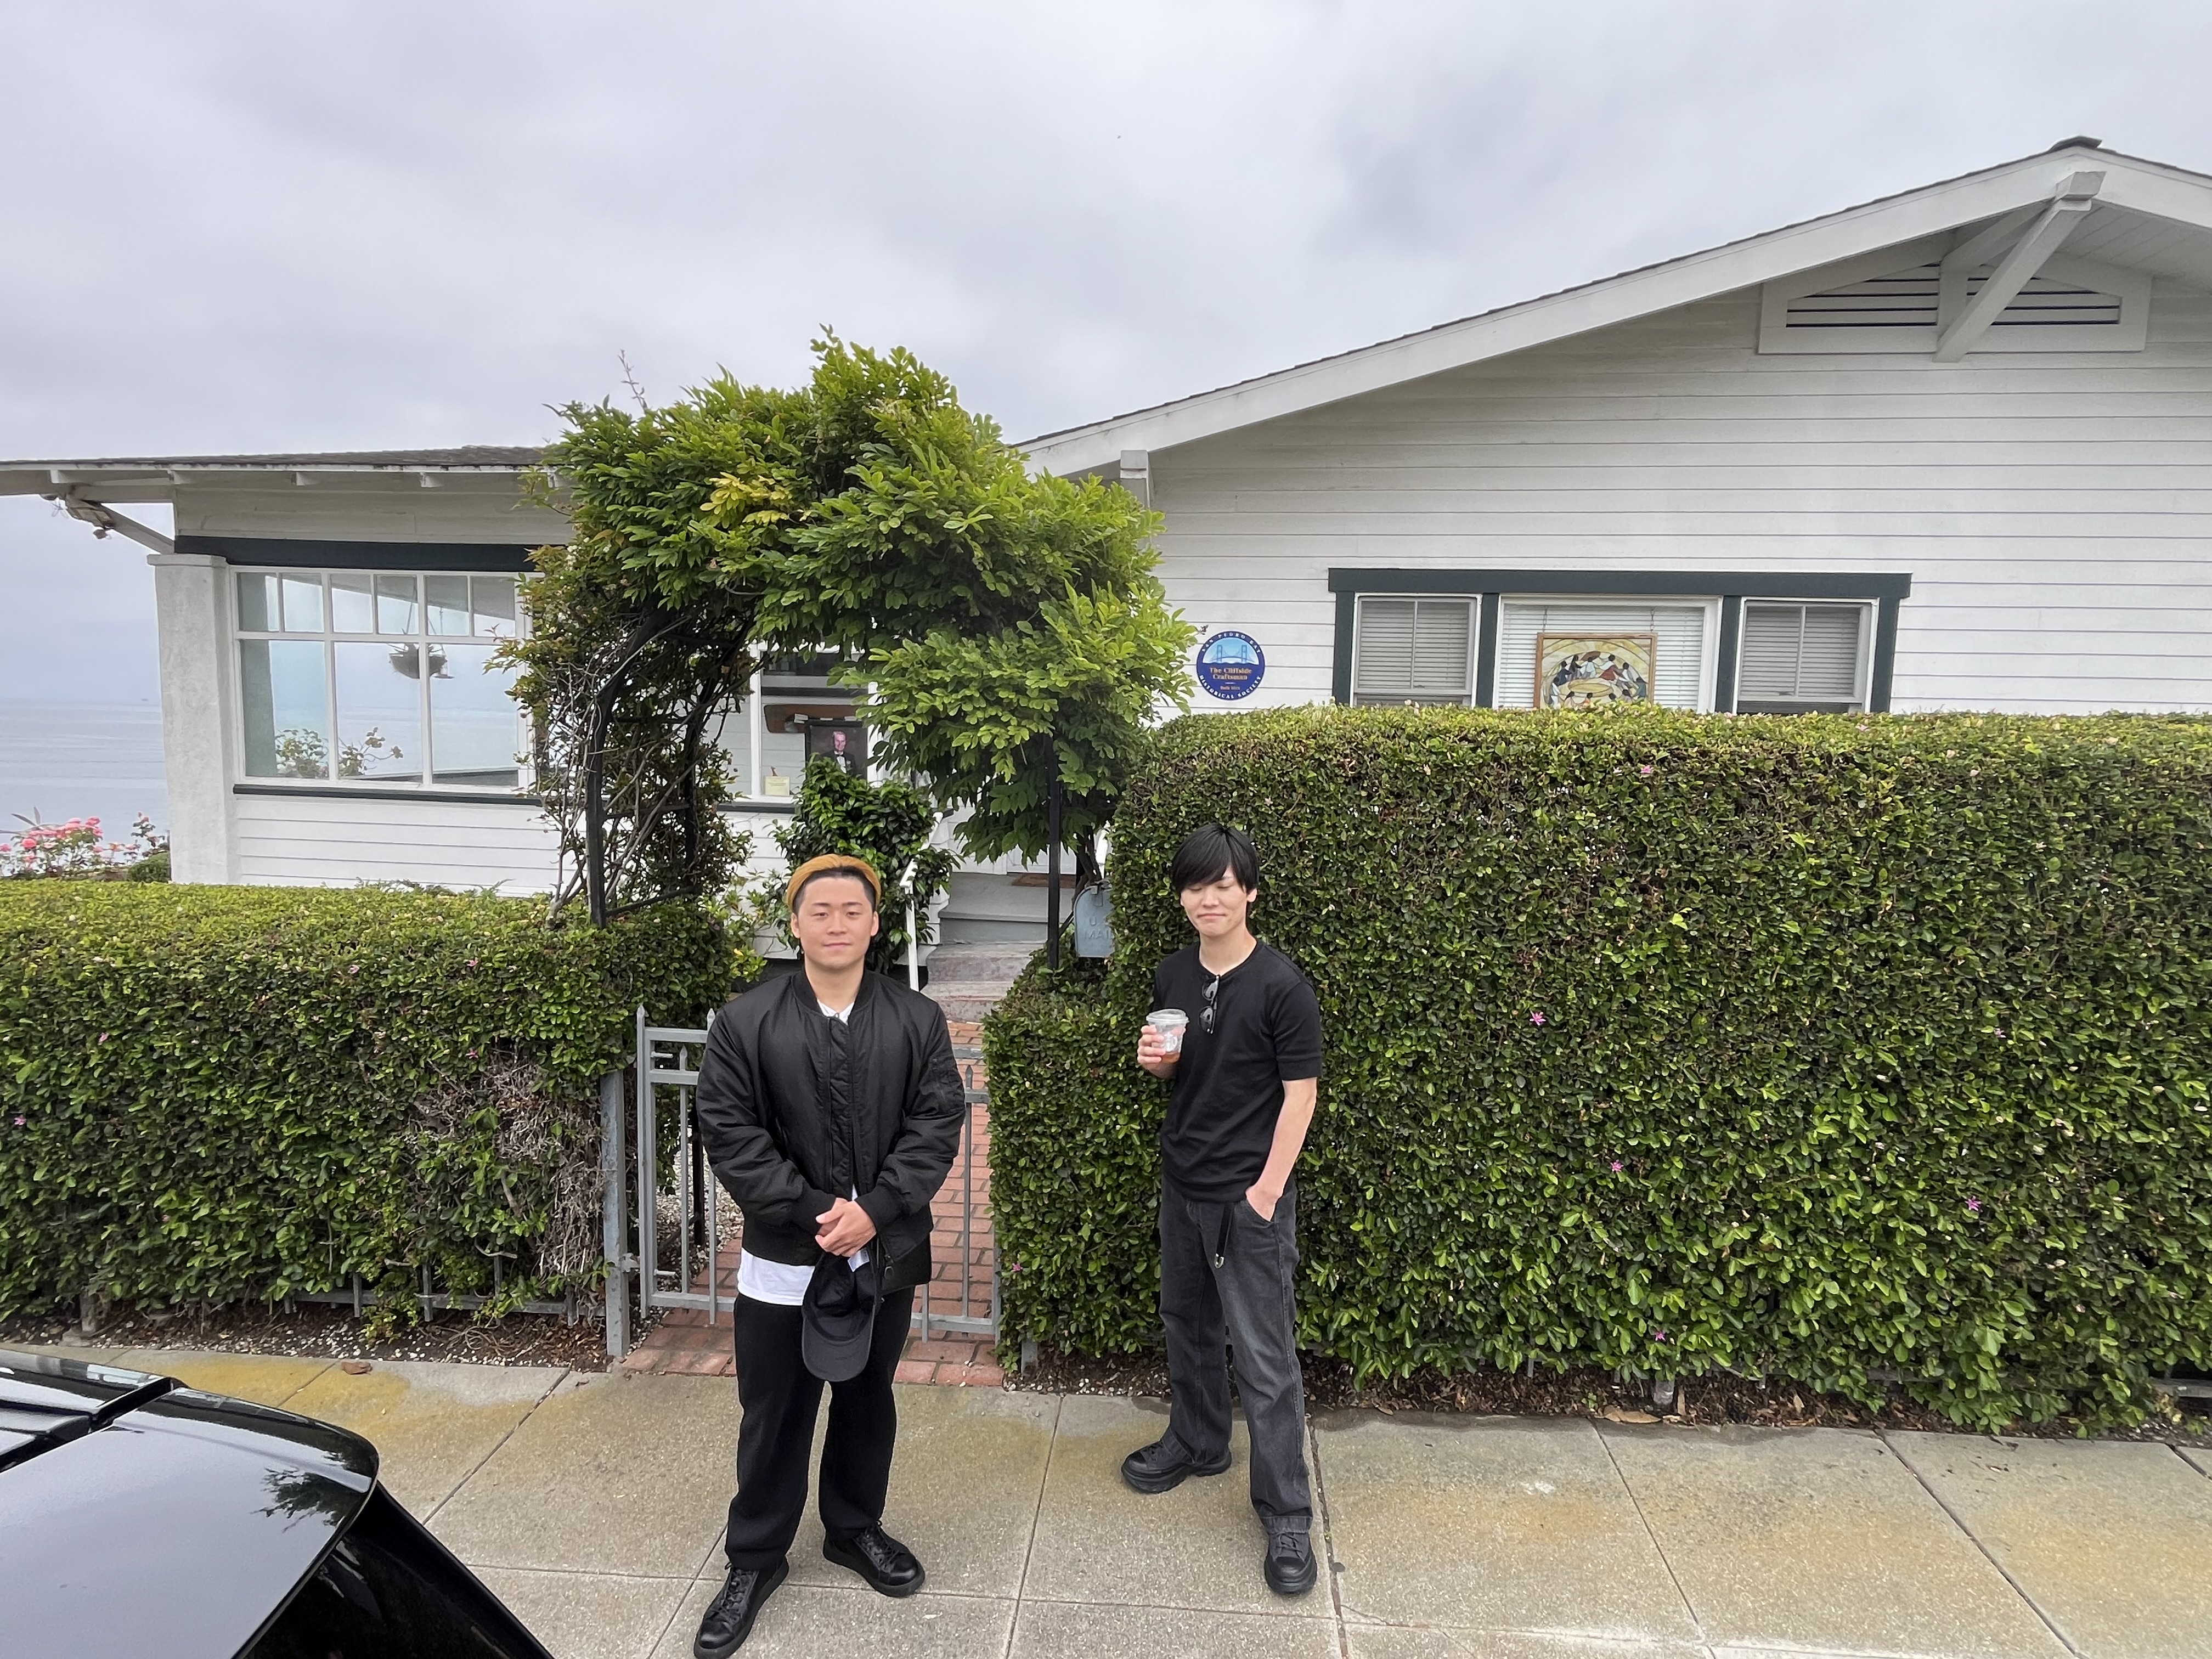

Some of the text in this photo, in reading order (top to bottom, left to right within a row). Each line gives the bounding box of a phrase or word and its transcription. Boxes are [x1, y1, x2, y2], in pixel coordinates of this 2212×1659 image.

[1201, 640, 1214, 652] SAN
[1249, 640, 1261, 653] BAY
[1199, 675, 1261, 699] HISTORICAL SOCIETY
